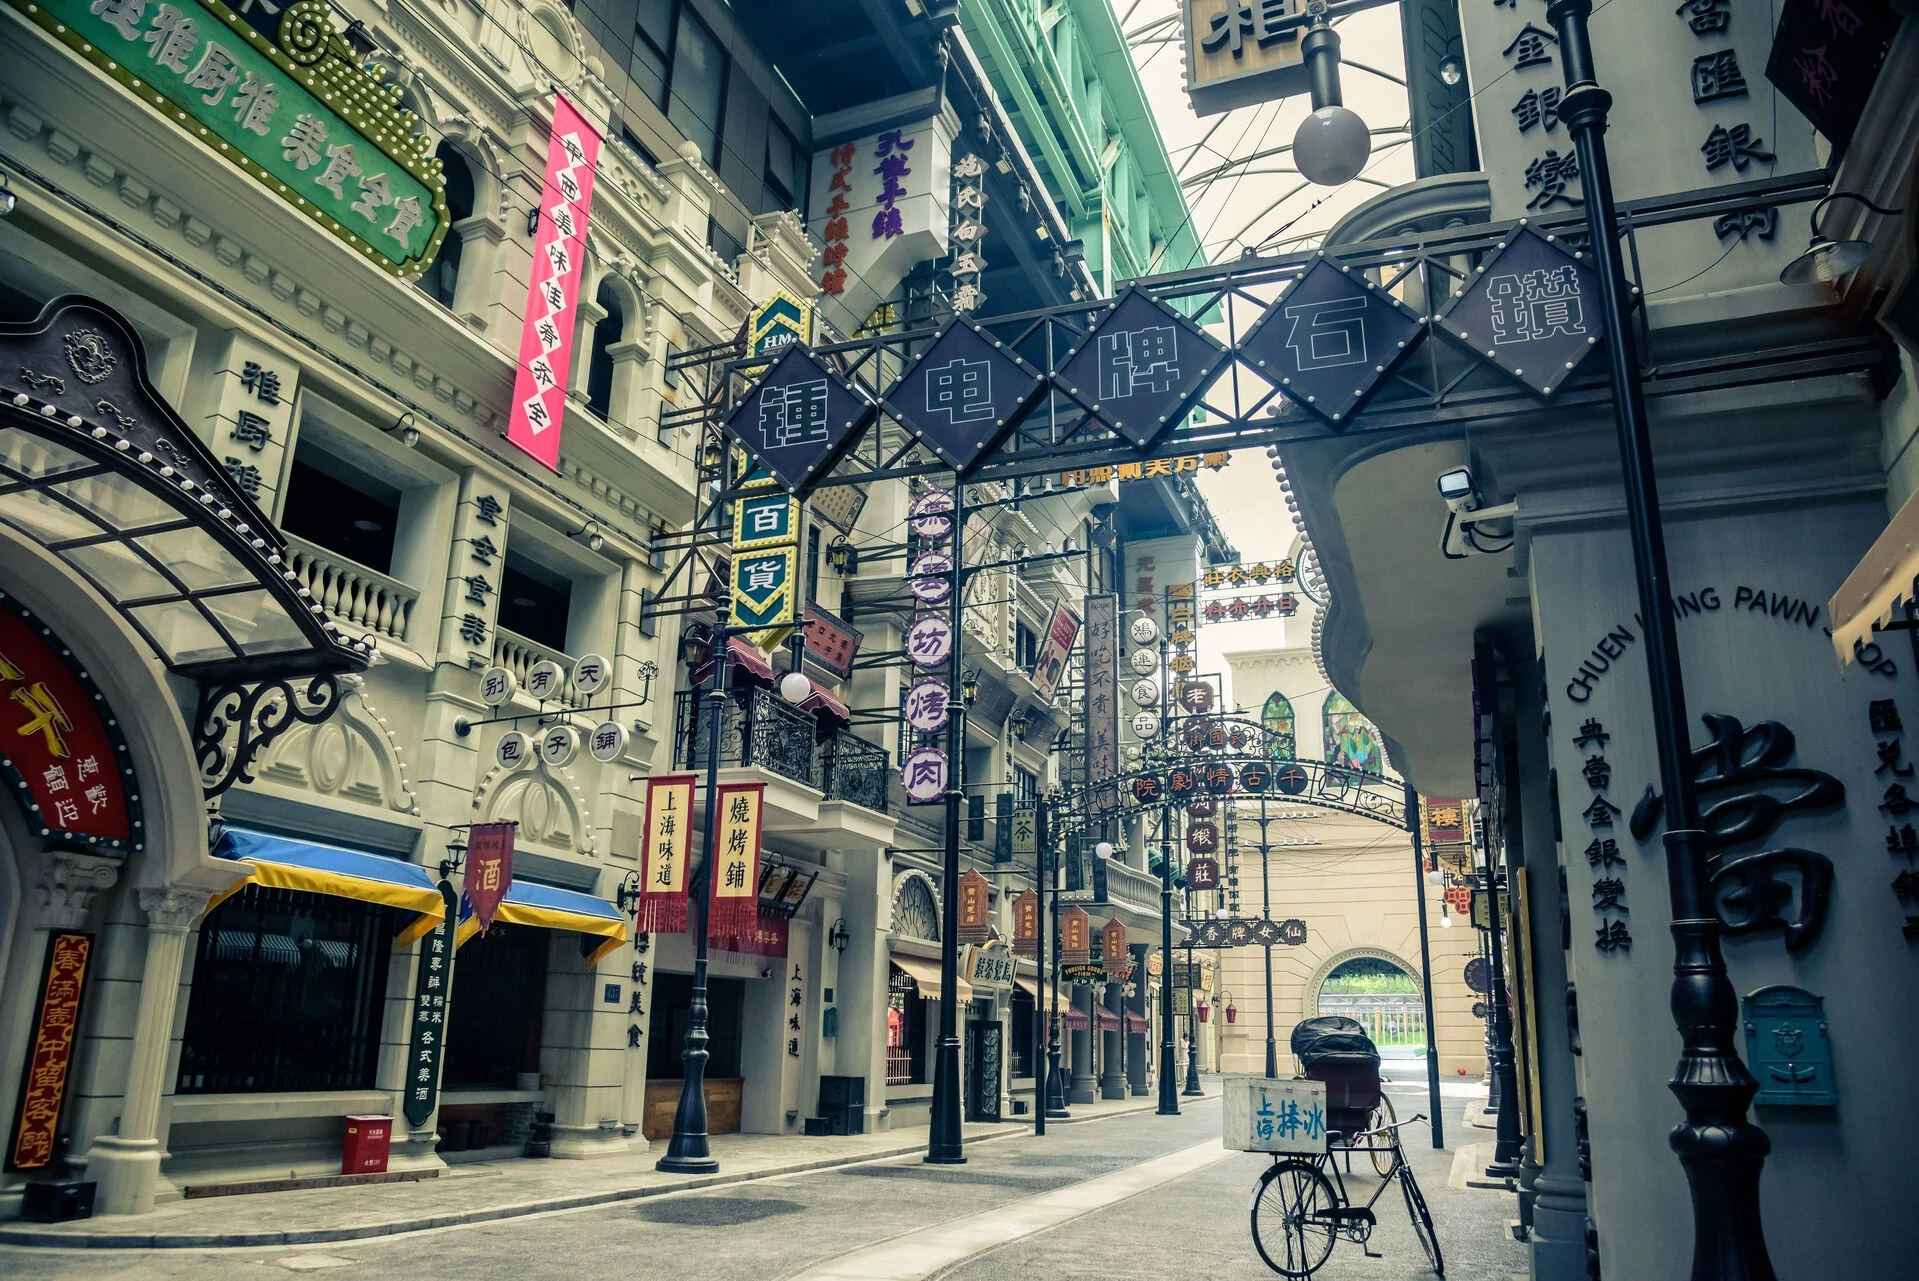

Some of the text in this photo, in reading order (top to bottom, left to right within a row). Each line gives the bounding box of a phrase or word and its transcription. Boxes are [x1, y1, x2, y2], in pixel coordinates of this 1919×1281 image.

[1566, 624, 1636, 704] CHUEN
[1734, 586, 1820, 629] PAWN
[475, 859, 502, 892] 酒
[655, 790, 677, 887] 上海味道
[1015, 820, 1034, 842] 茶
[788, 963, 803, 1058] 上海味道
